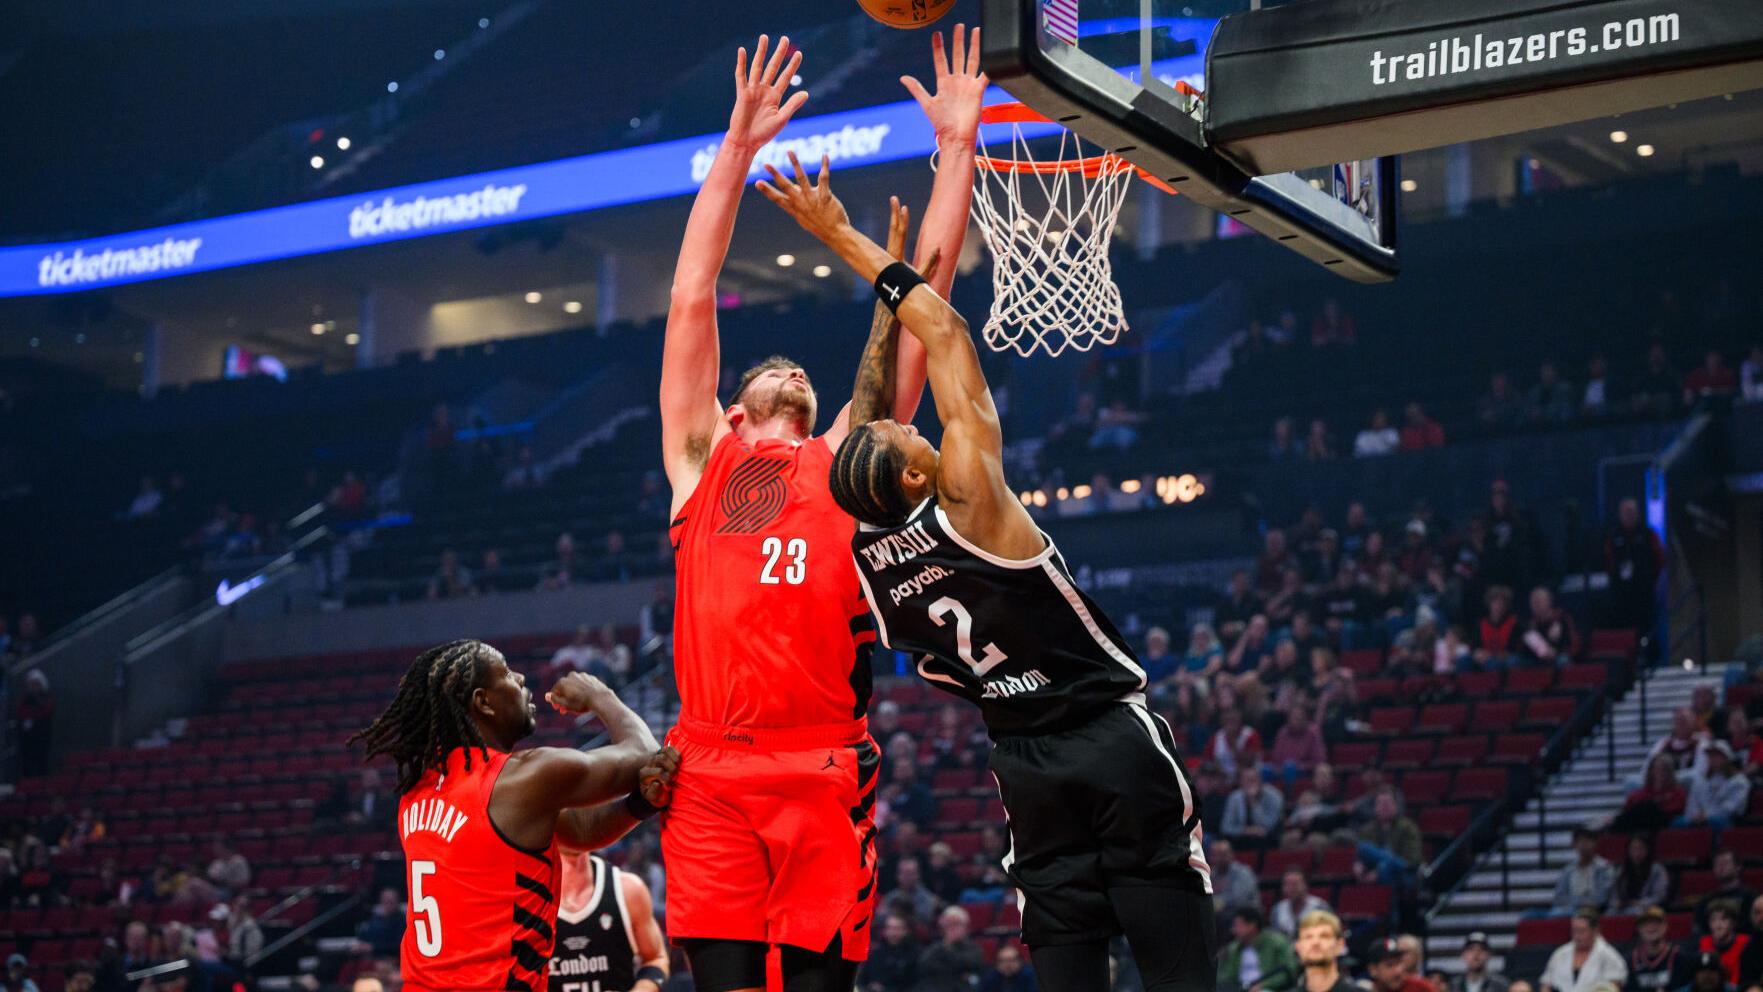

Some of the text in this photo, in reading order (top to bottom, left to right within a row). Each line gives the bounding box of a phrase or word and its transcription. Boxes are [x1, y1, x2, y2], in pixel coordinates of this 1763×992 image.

[1370, 12, 1680, 85] trailblazers.com
[691, 123, 890, 183] tietmaster
[348, 183, 527, 241] ticketmaster
[38, 237, 202, 287] ticketmaster
[759, 536, 808, 585] 23
[928, 596, 1009, 677] 2
[403, 798, 468, 843] HOLIDAY
[411, 859, 442, 957] 5
[548, 953, 609, 977] London
